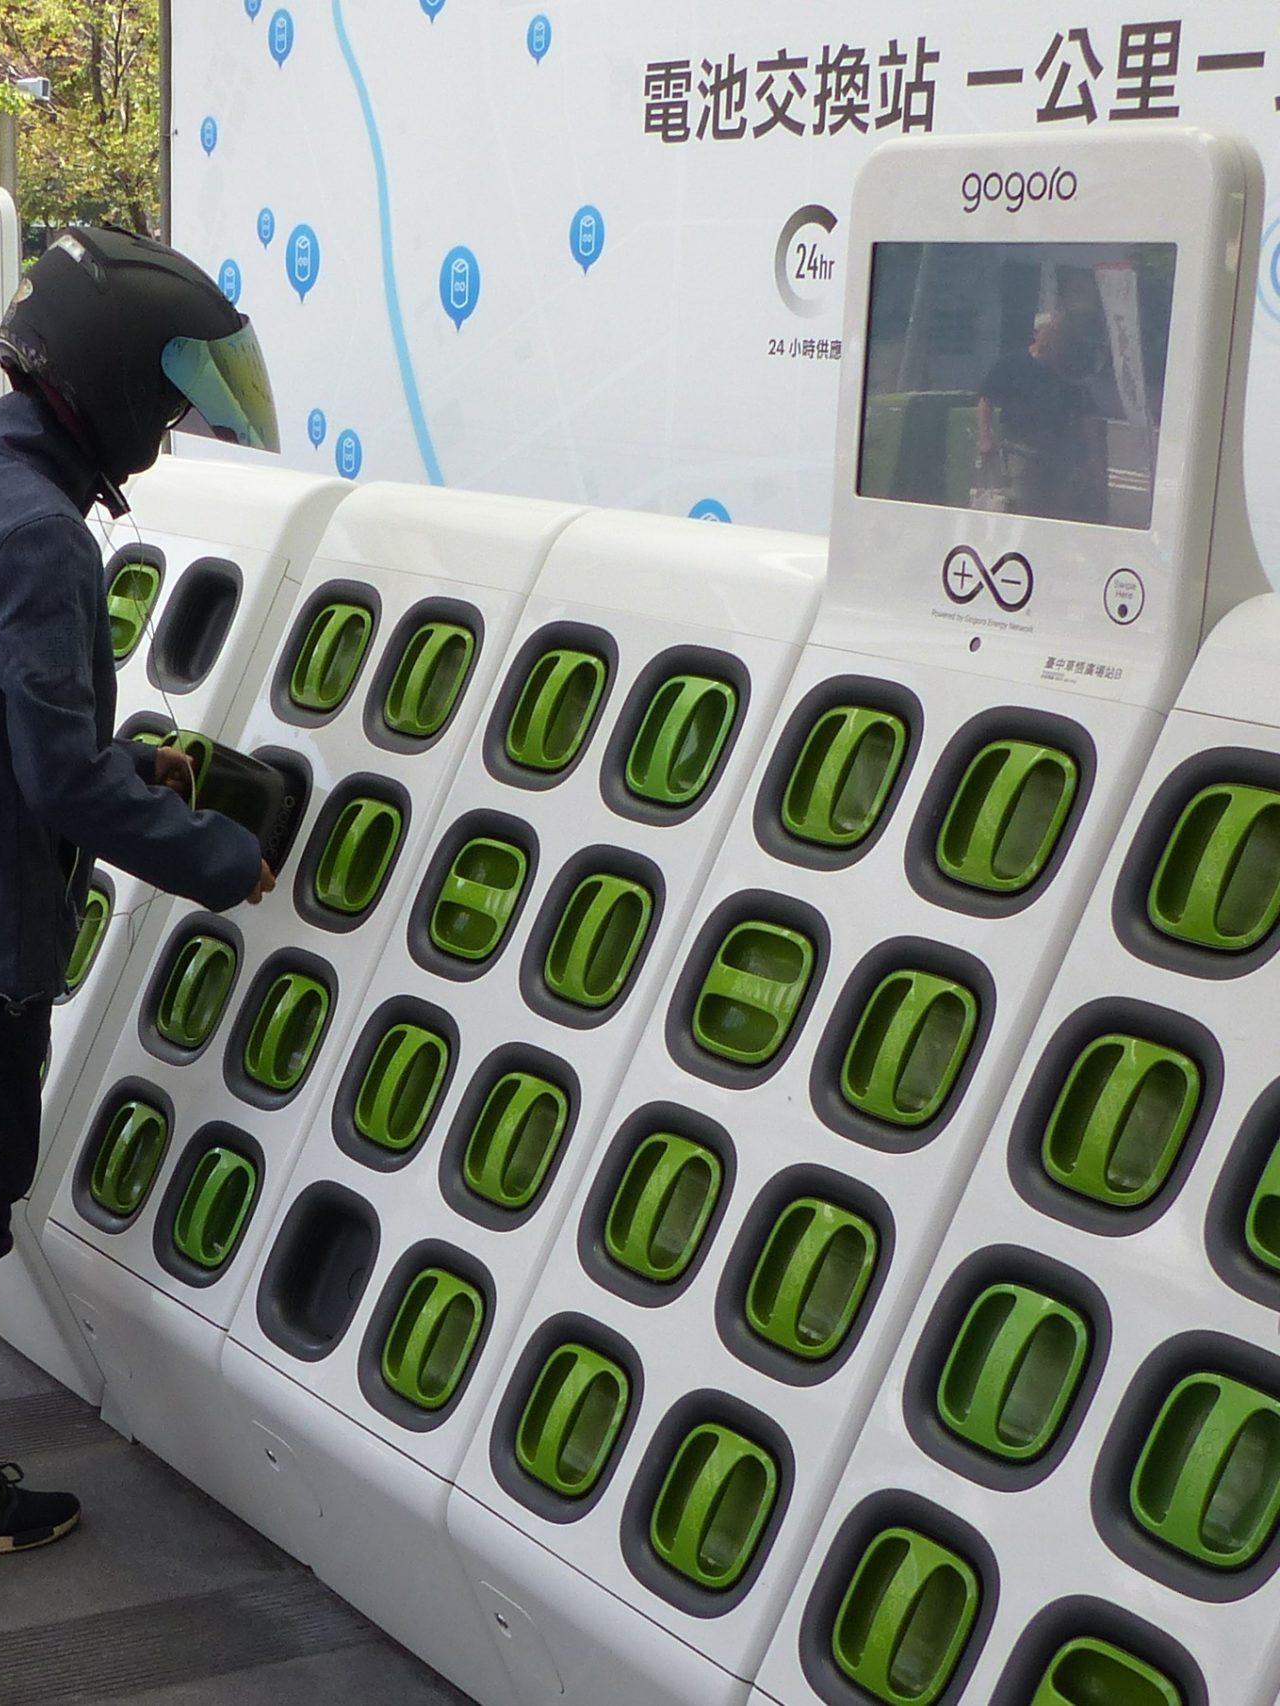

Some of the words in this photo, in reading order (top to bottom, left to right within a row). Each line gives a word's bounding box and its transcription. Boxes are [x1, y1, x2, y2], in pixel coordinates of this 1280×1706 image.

[643, 36, 941, 144] 電池交換站
[967, 19, 1280, 126] 一公里一
[961, 166, 1078, 213] gogoro
[795, 243, 835, 280] 24hr
[767, 338, 785, 356] 24
